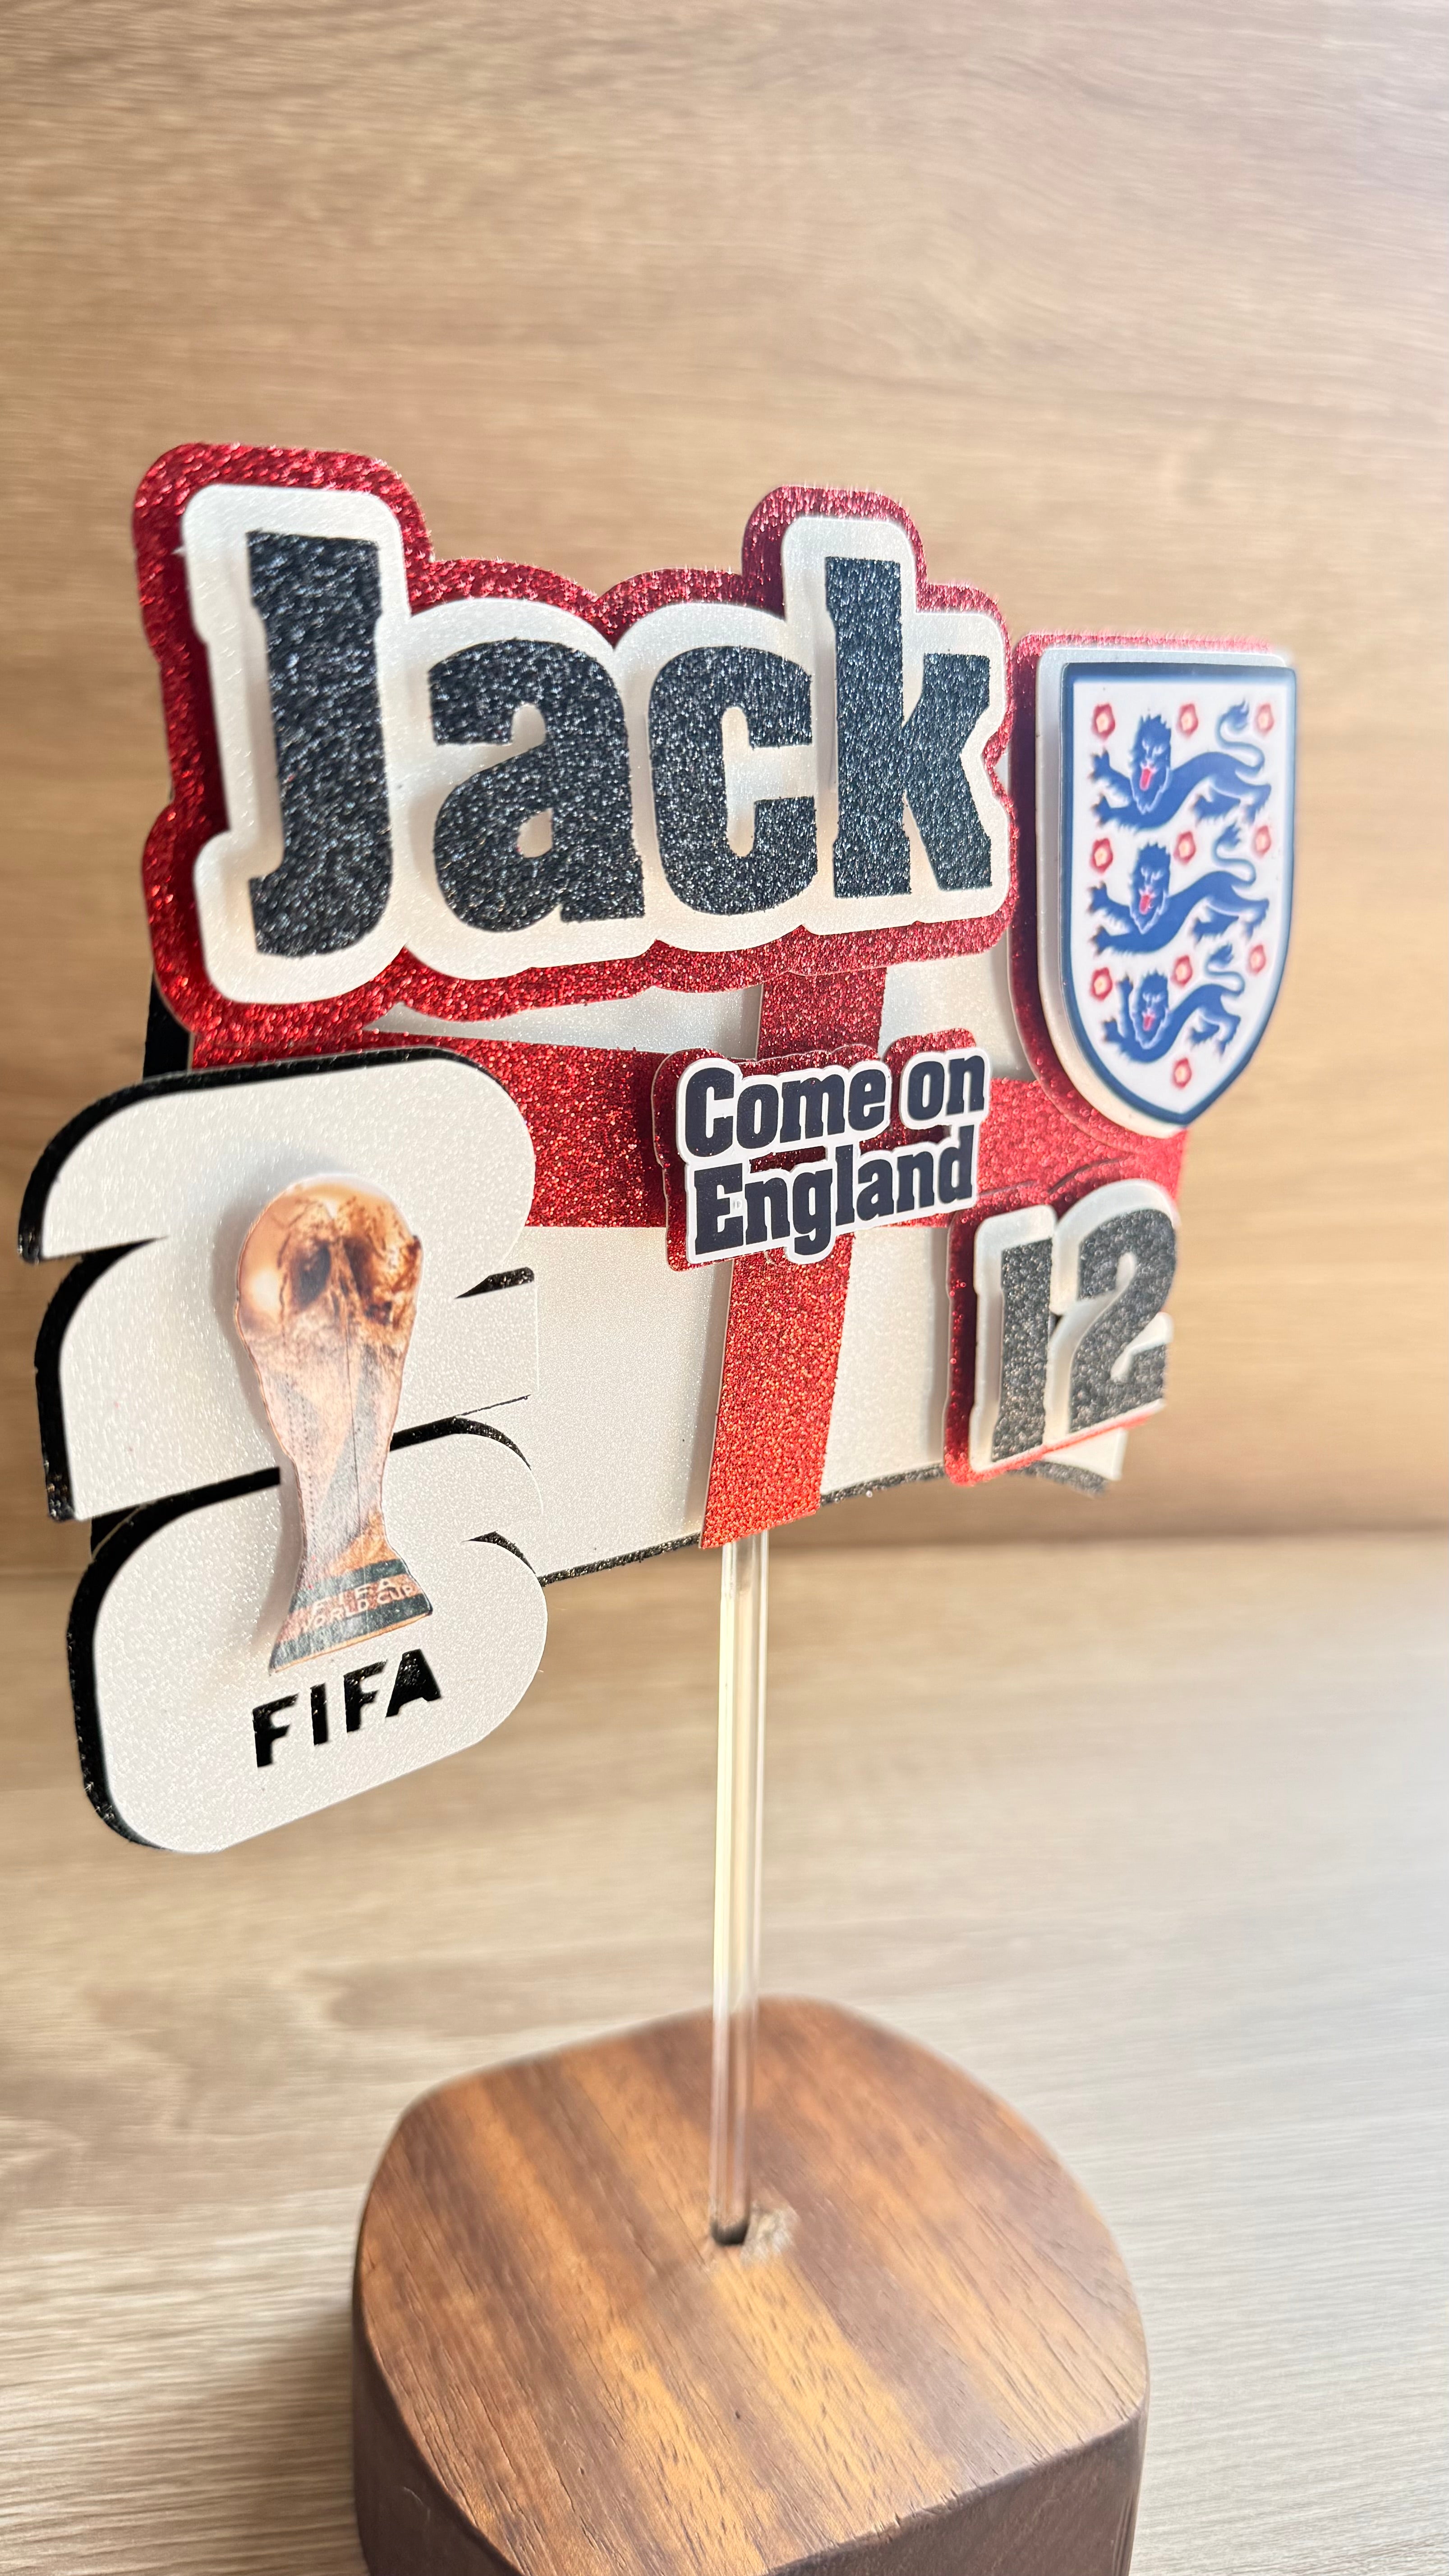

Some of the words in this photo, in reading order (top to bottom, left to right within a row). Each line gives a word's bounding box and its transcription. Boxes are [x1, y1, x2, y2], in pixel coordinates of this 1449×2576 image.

[246, 529, 993, 959] Jack
[684, 1067, 887, 1157] Come
[908, 1054, 985, 1121] on
[694, 1125, 975, 1256] England
[992, 1209, 1177, 1462] 12
[376, 1586, 418, 1605] CUP
[252, 1648, 442, 1768] FIFA
